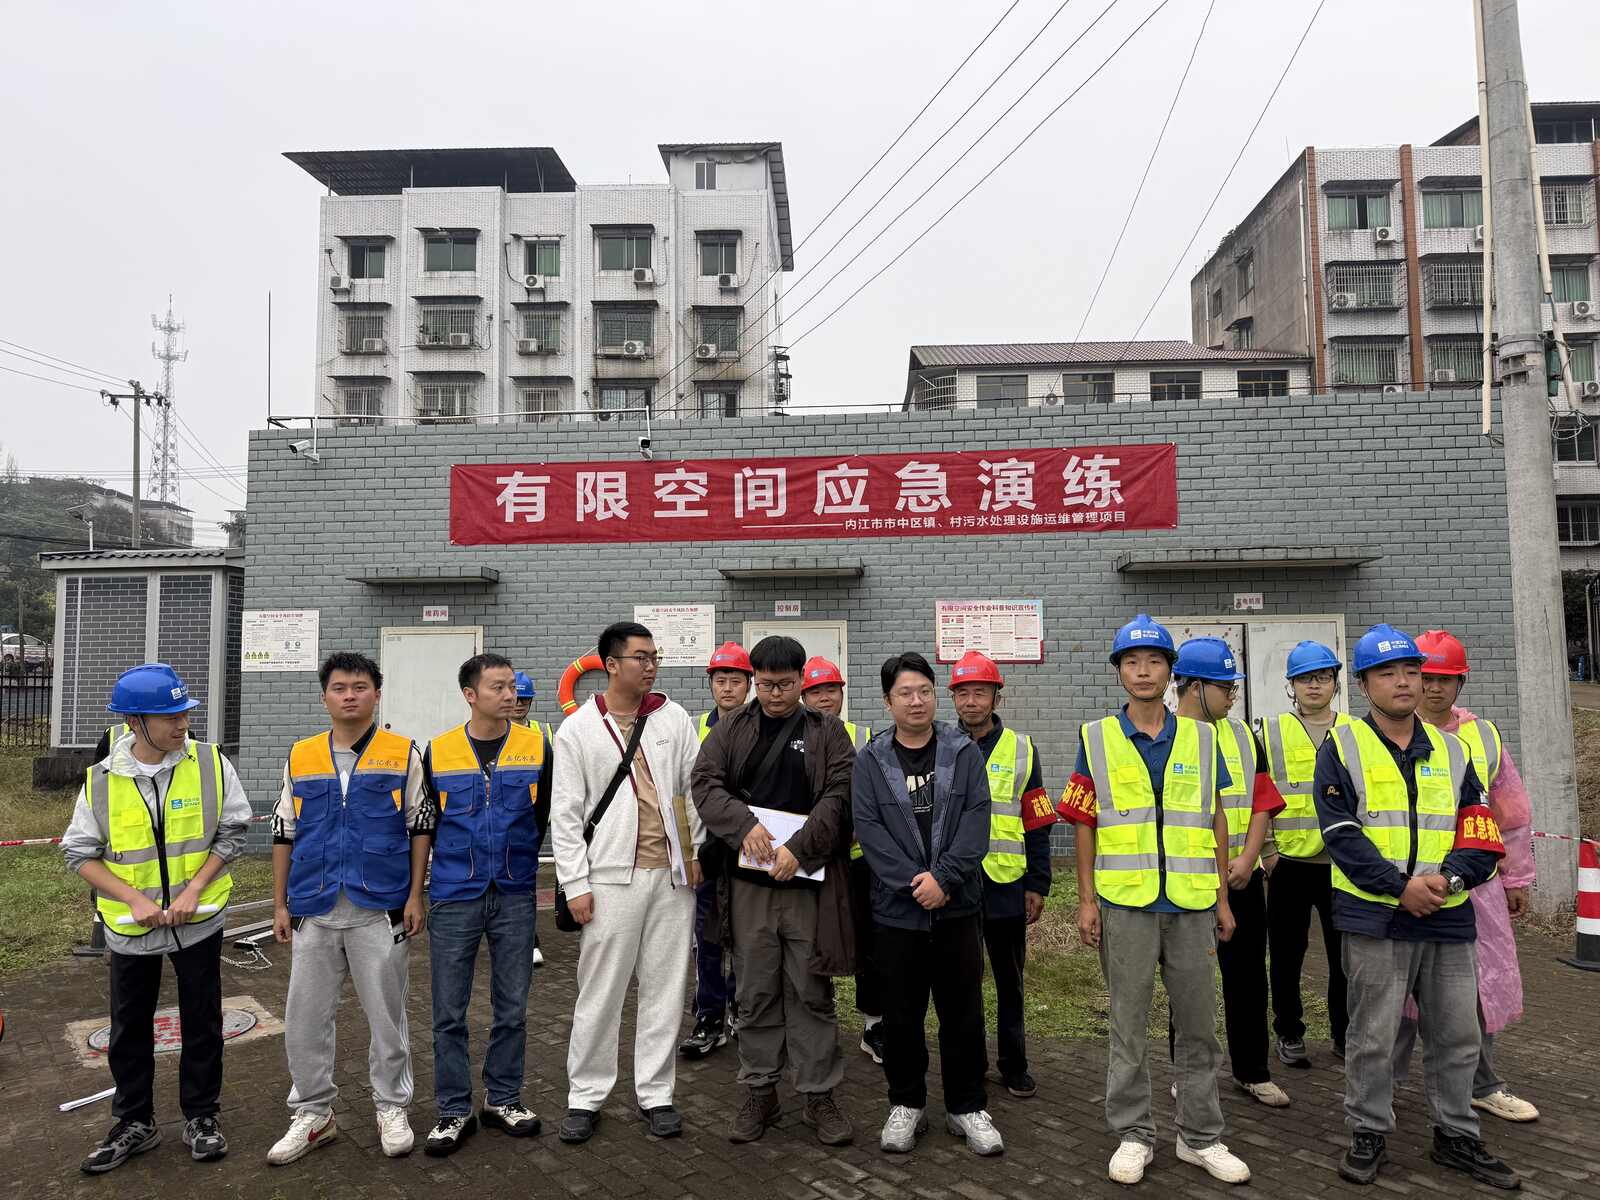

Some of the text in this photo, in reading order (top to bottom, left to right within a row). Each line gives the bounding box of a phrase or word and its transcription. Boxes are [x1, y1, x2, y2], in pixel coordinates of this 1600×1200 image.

[496, 454, 1125, 522] 有限空间应急演练
